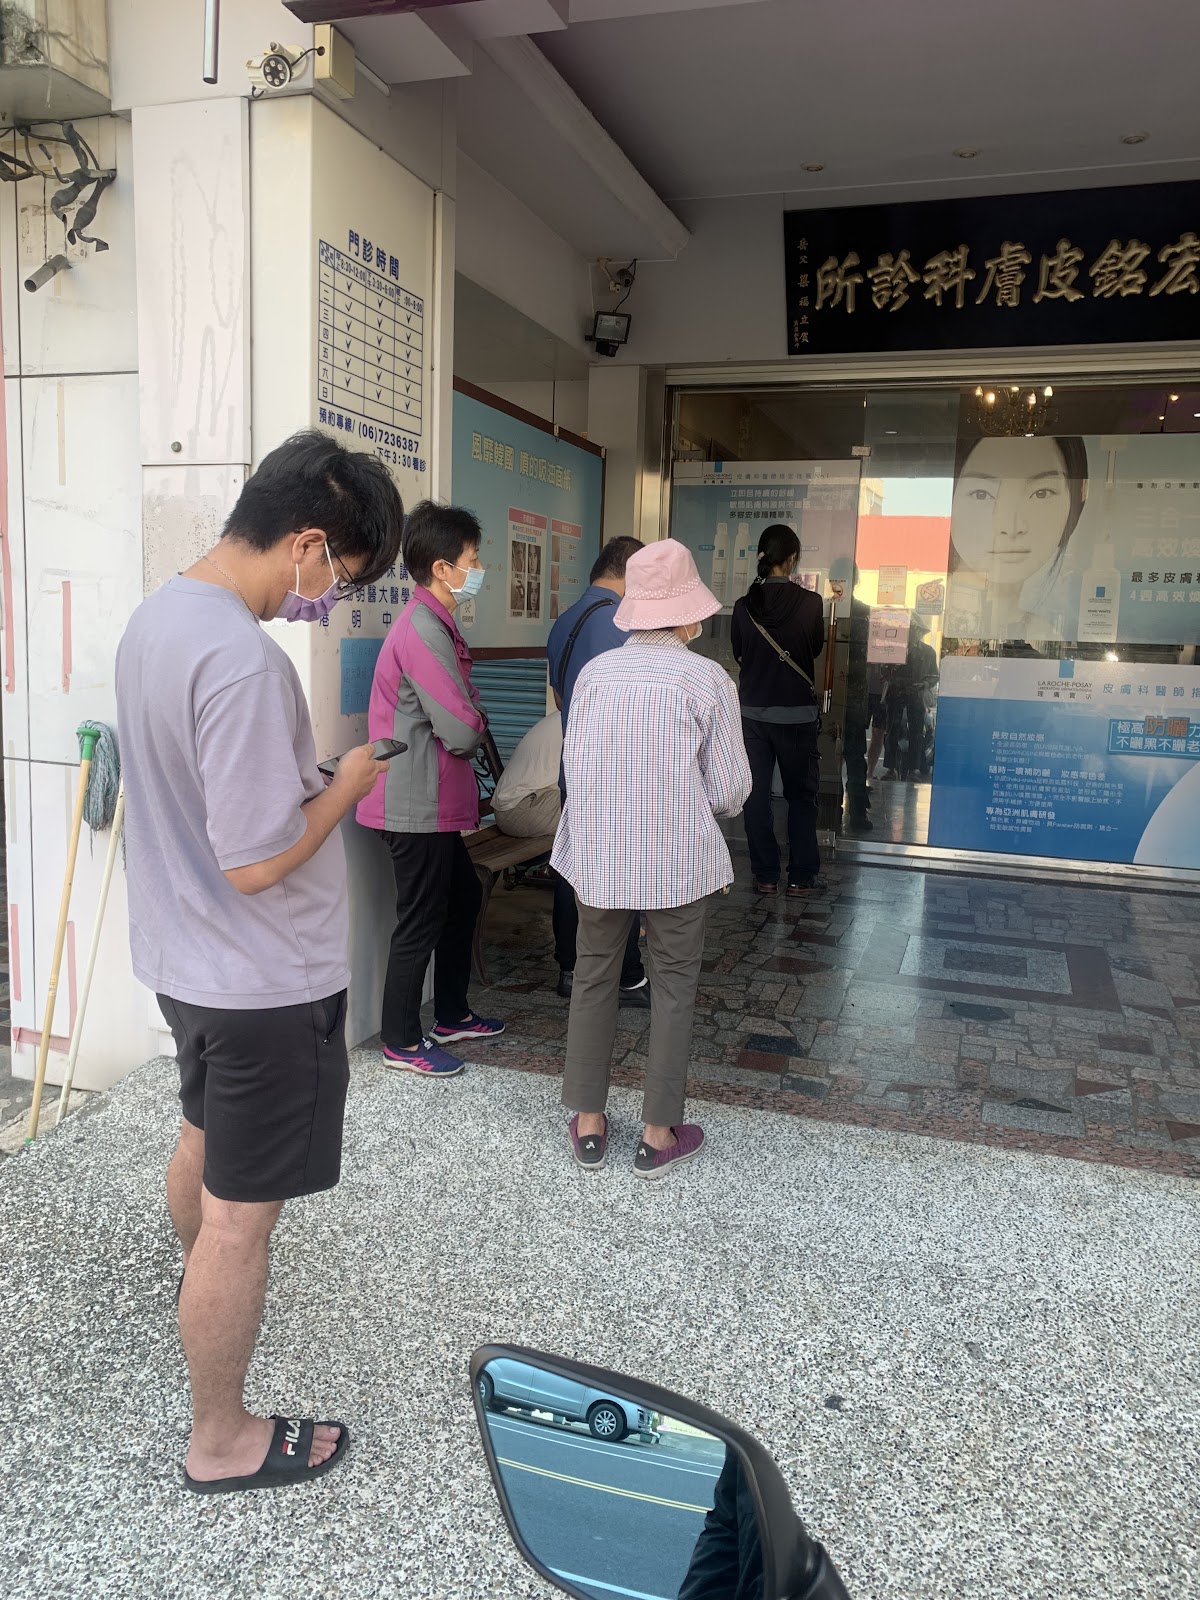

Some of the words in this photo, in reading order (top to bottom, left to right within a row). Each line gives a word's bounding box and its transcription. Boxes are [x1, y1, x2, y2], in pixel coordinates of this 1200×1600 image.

[349, 229, 399, 280] 門診時間
[323, 289, 330, 302] 二
[323, 308, 330, 321] 三
[323, 327, 329, 340] 四
[322, 347, 329, 359] 五
[322, 367, 329, 379] 六
[322, 387, 328, 398] 日
[358, 421, 419, 454] (06)7236387
[471, 431, 515, 473] 風靡韓國
[1116, 736, 1200, 753] 不曬黑不曬老
[282, 1419, 301, 1456] FILA
